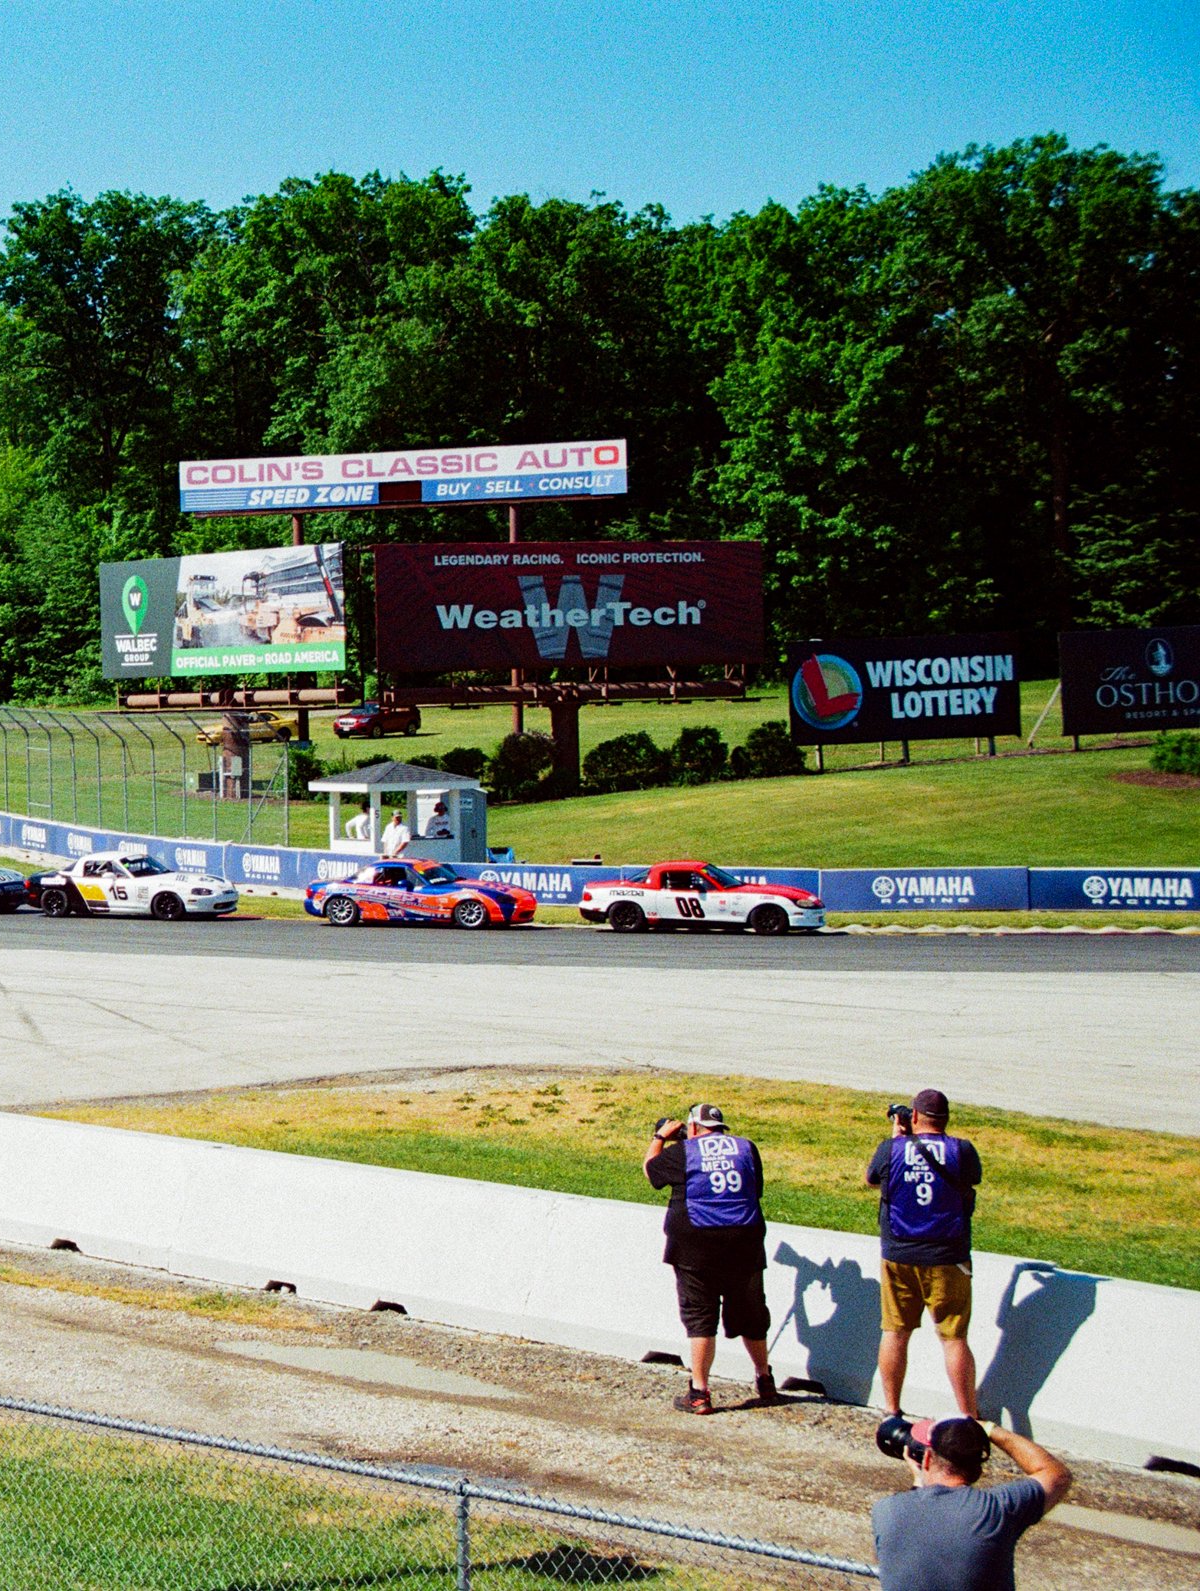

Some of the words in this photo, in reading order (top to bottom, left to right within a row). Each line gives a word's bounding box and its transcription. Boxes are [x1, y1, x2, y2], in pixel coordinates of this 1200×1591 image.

[186, 461, 324, 485] COLIN'S
[341, 452, 498, 479] CLASSIC
[516, 445, 619, 470] AUTO
[436, 482, 471, 496] BUY
[484, 480, 523, 493] SELL
[538, 474, 614, 491] CONSULT
[247, 487, 310, 506] SPEED
[314, 485, 375, 503] ZONE
[434, 554, 509, 566] LEGENDARY
[513, 553, 564, 565] RACING.
[576, 553, 620, 564] ICONIC
[623, 552, 705, 564] PROTECTION.
[129, 592, 141, 606] W
[115, 638, 157, 653] WALBEC
[124, 653, 150, 662] GROUP
[176, 656, 220, 668] OFFICIAL
[222, 654, 256, 667] PAVER
[265, 652, 292, 664] ROAD
[294, 650, 339, 663] AMERICA
[865, 654, 1014, 688] WISCONSIN
[891, 686, 998, 719] LOTTERY
[1125, 710, 1168, 719] RESORT
[109, 886, 128, 900] 15
[895, 876, 975, 896] YAMAHA
[1107, 877, 1194, 898] YAMAHA
[675, 896, 705, 918] 08
[709, 1170, 742, 1194] 99
[915, 1183, 933, 1206] 9
